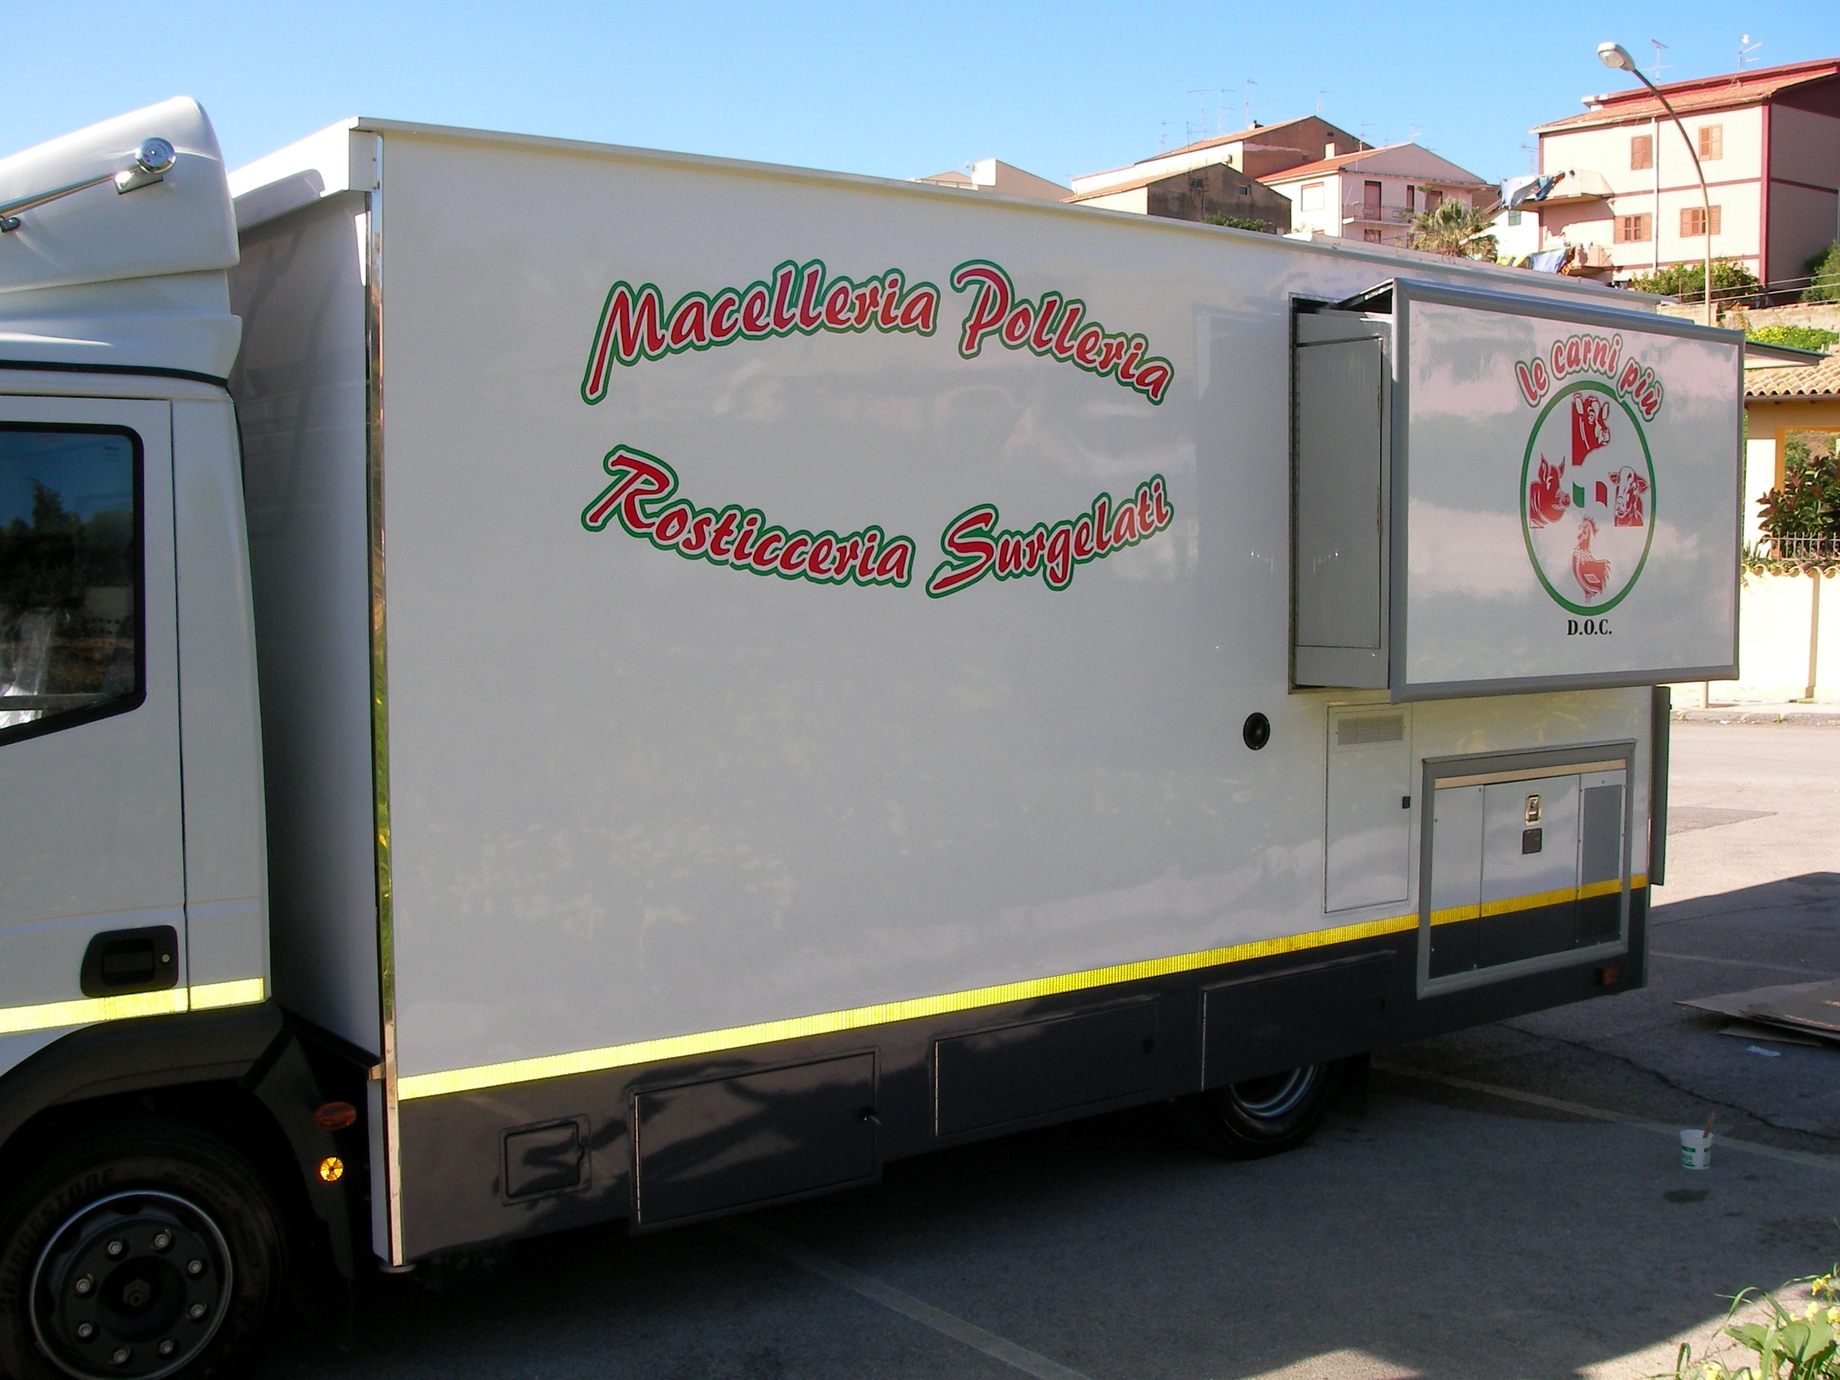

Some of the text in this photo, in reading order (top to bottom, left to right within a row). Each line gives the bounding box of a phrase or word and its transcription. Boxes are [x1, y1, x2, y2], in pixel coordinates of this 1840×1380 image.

[585, 264, 1171, 401] Macelleria Polleria
[1517, 335, 1662, 418] le carni più
[585, 450, 1171, 594] Rosticceria Surgelati
[1567, 618, 1612, 636] D.O.C.
